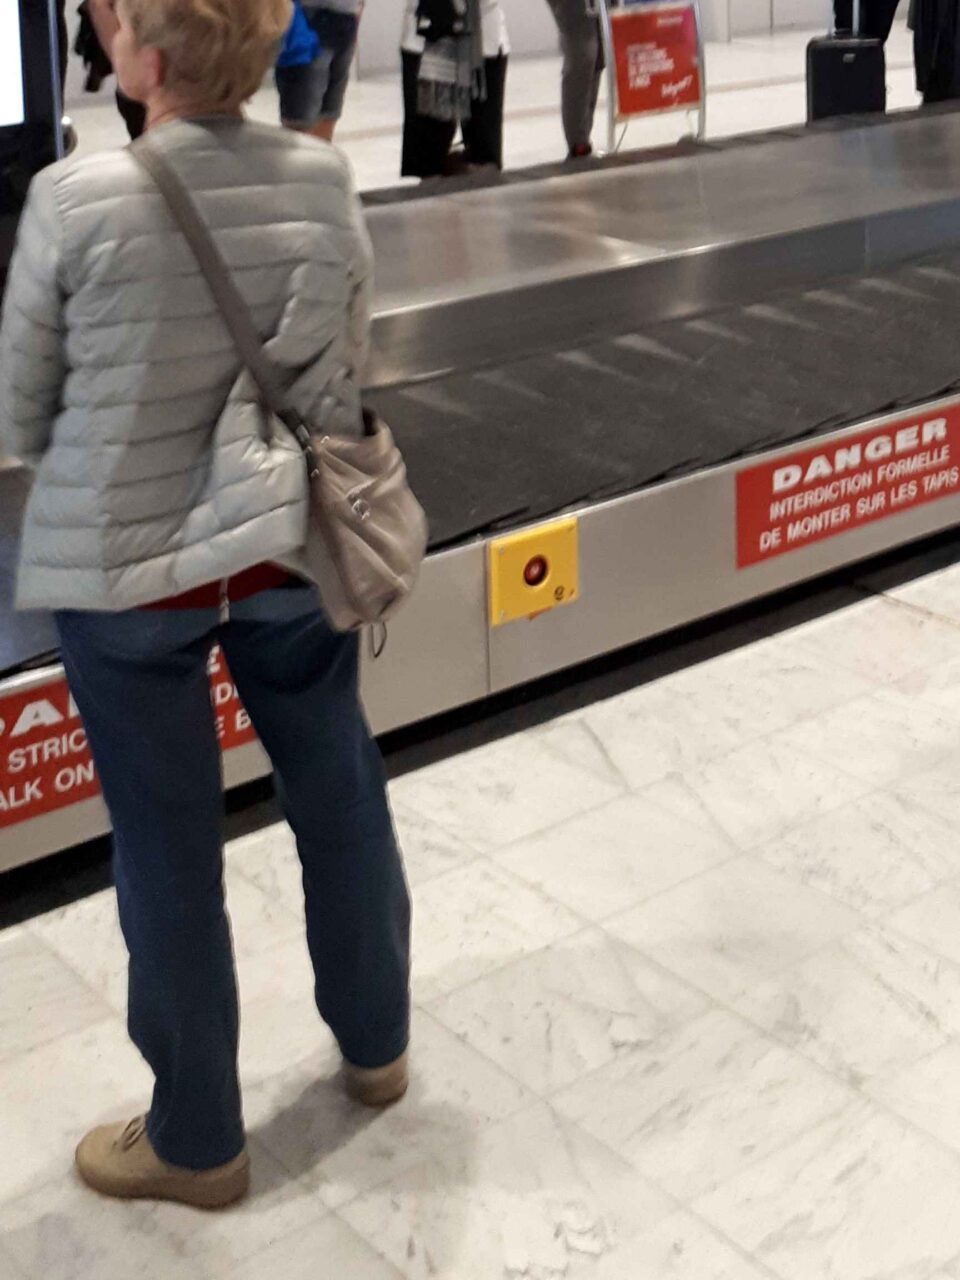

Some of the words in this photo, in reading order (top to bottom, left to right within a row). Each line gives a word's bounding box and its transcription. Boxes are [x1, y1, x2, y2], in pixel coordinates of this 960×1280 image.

[769, 472, 873, 521] INTERDICTION
[877, 445, 950, 483] FORMELLE
[772, 418, 947, 492] DANGER
[759, 527, 782, 552] DE
[786, 505, 851, 542] MONTER
[856, 493, 887, 517] SUR
[890, 481, 918, 503] LES
[923, 467, 960, 493] TAPIS
[8, 727, 88, 773] STRIC
[54, 759, 94, 792] ON
